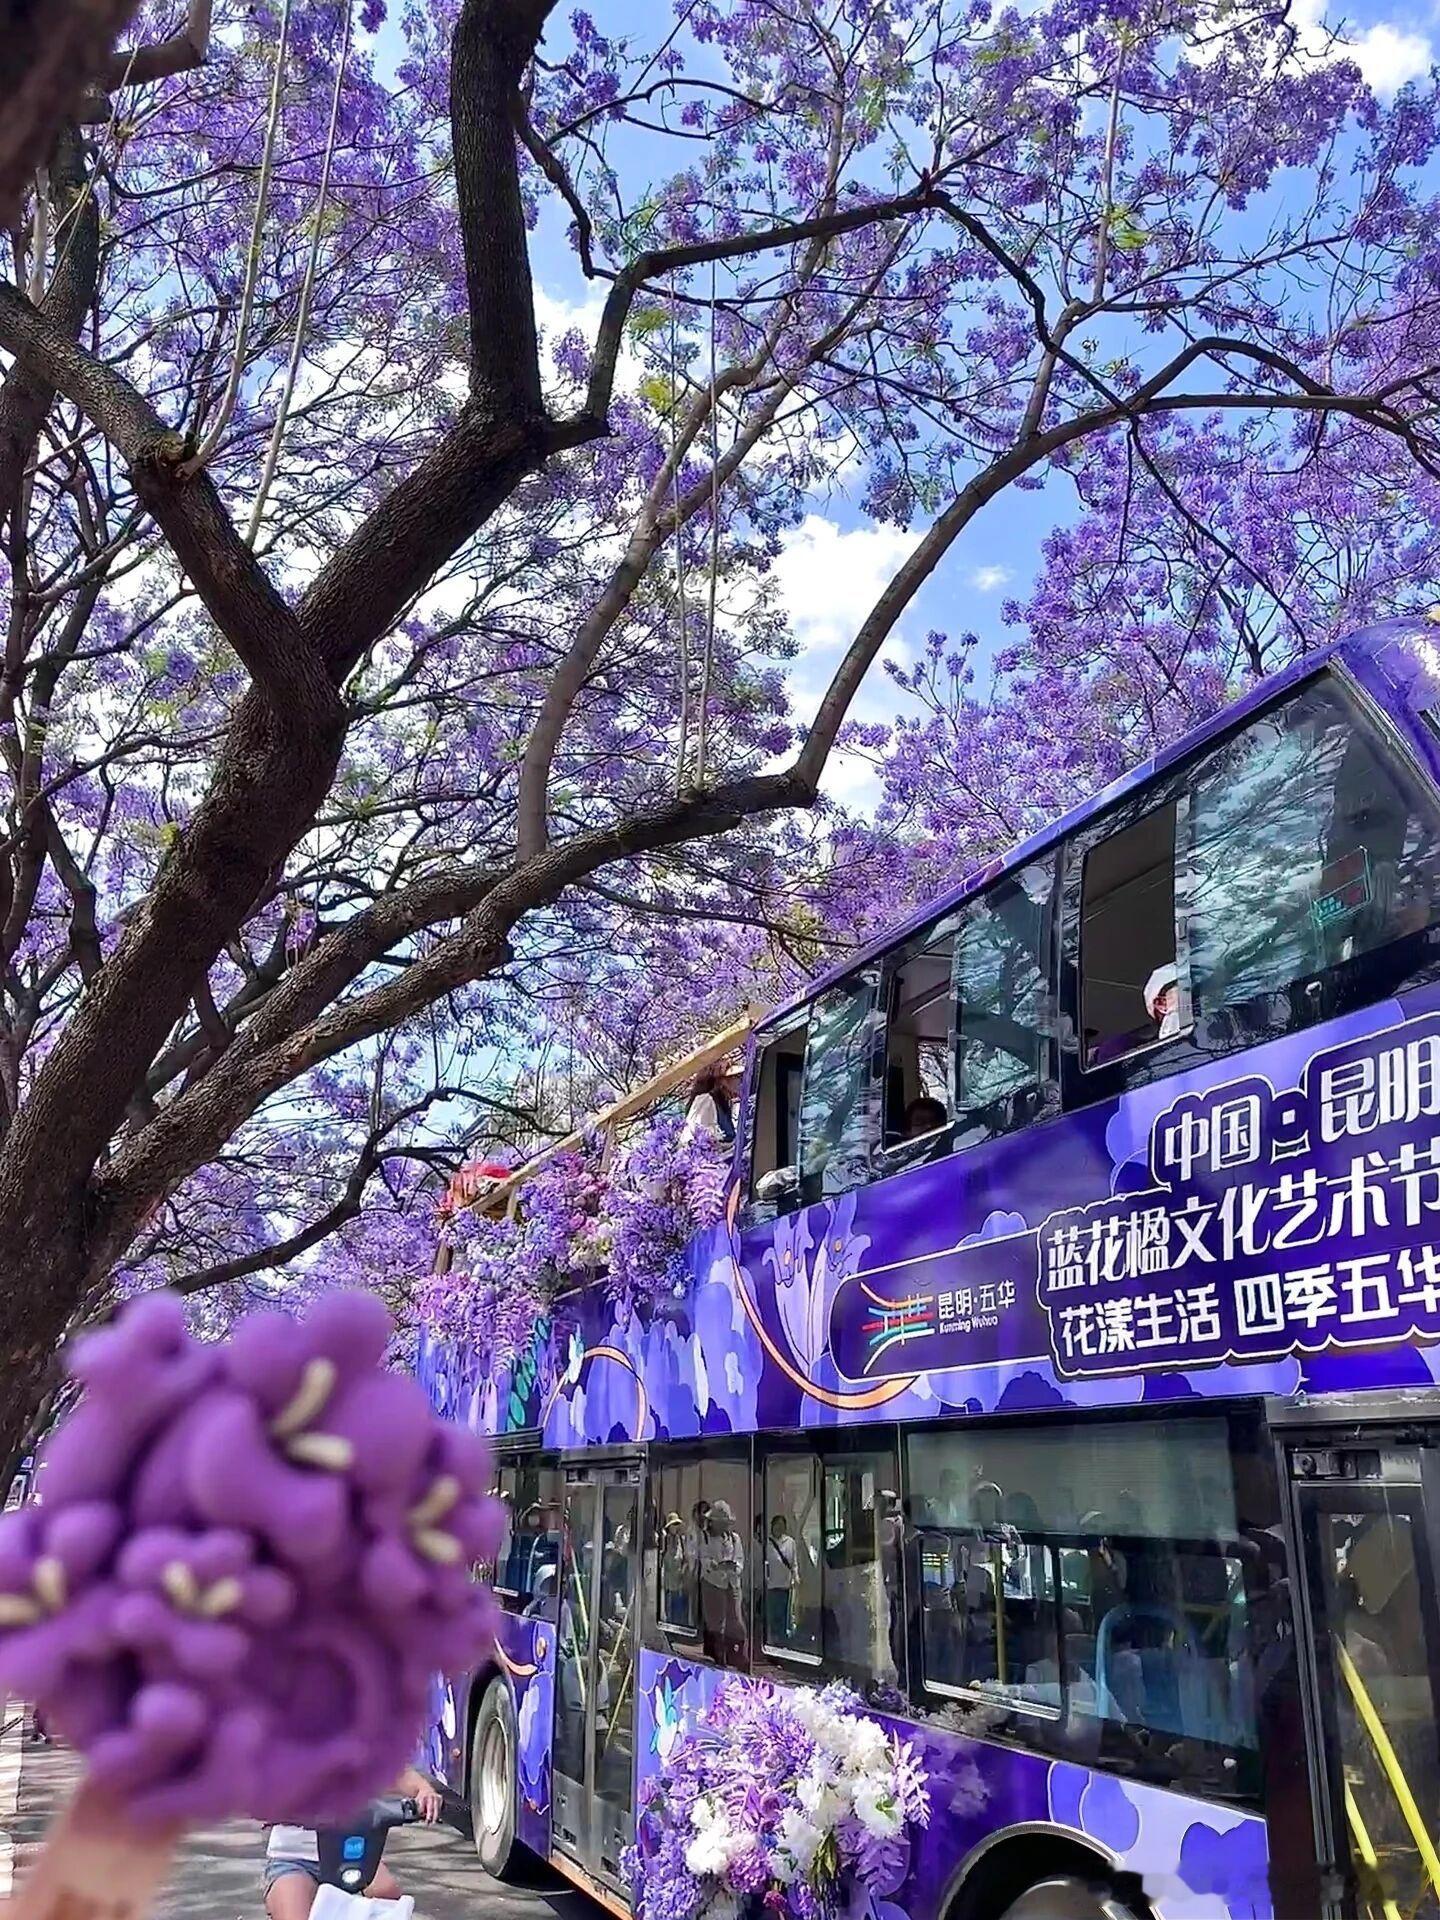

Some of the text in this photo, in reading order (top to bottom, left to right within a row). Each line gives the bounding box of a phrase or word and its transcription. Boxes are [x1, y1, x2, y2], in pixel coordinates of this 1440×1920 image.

[1046, 1138, 1440, 1292] 蓝花楹文化艺术节
[1058, 1246, 1440, 1358] 花漾生活 四季五华
